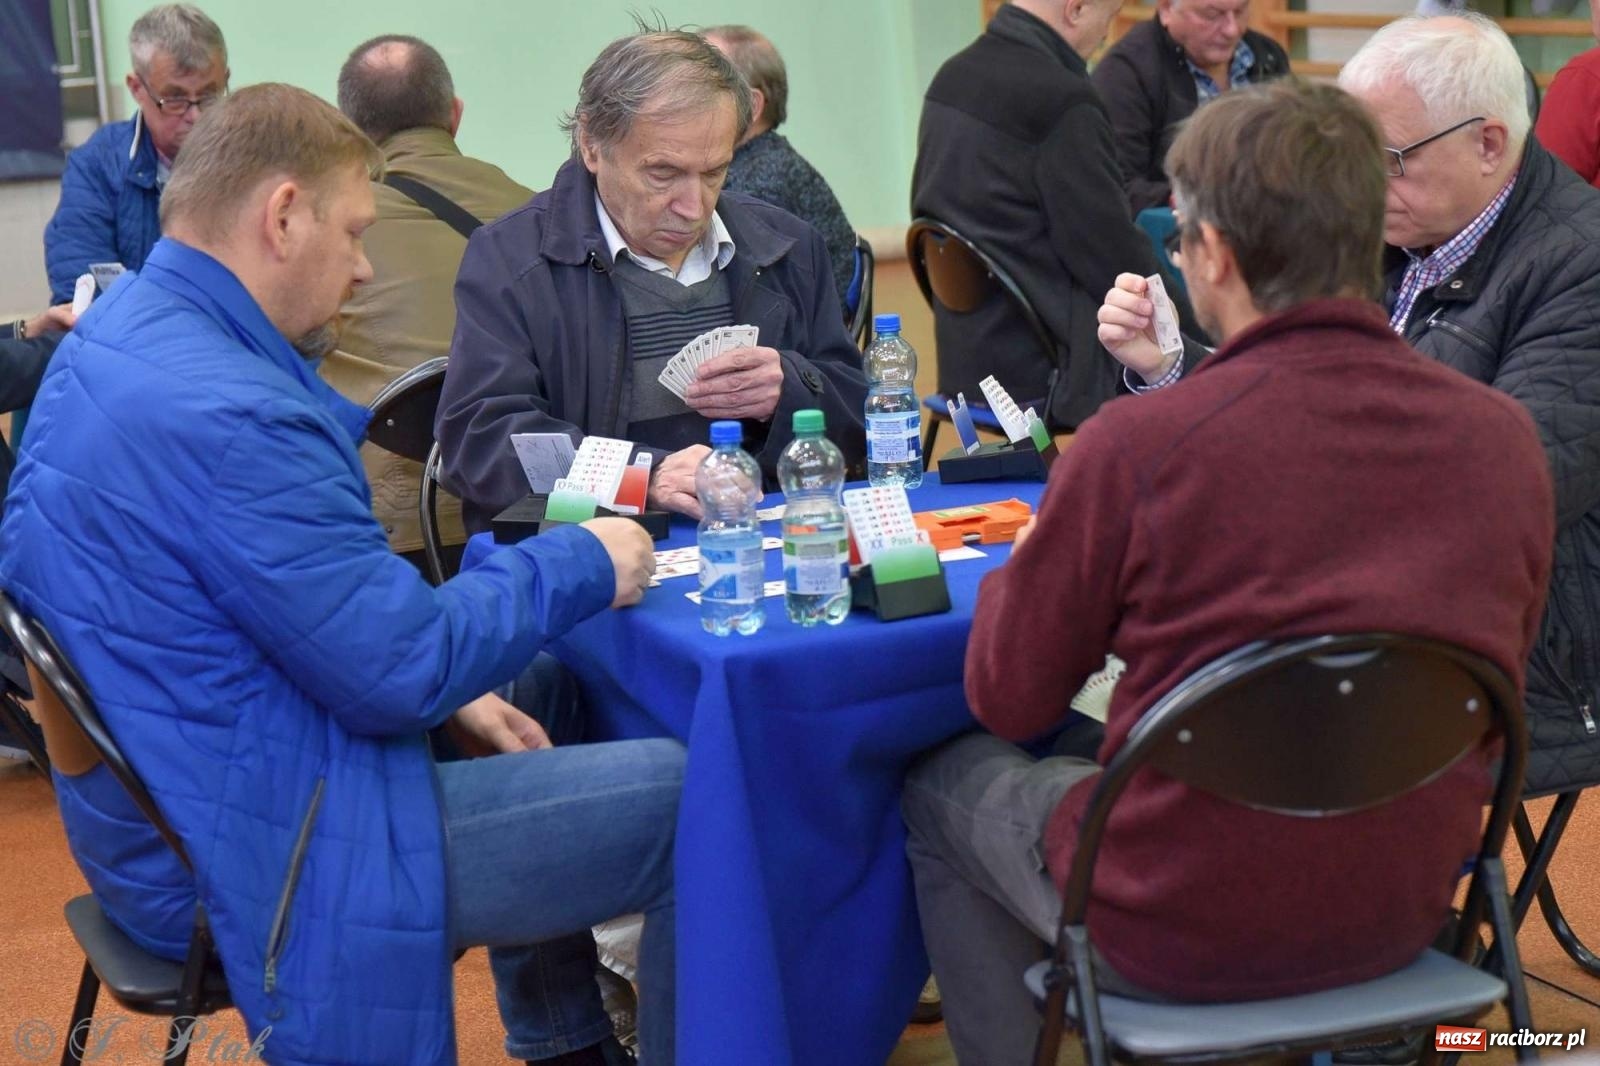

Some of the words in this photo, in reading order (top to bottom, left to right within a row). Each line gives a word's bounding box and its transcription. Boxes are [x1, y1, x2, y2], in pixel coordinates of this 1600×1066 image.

[568, 482, 585, 491] Pass
[871, 537, 883, 549] XX
[891, 535, 913, 546] Pass
[916, 532, 924, 543] X
